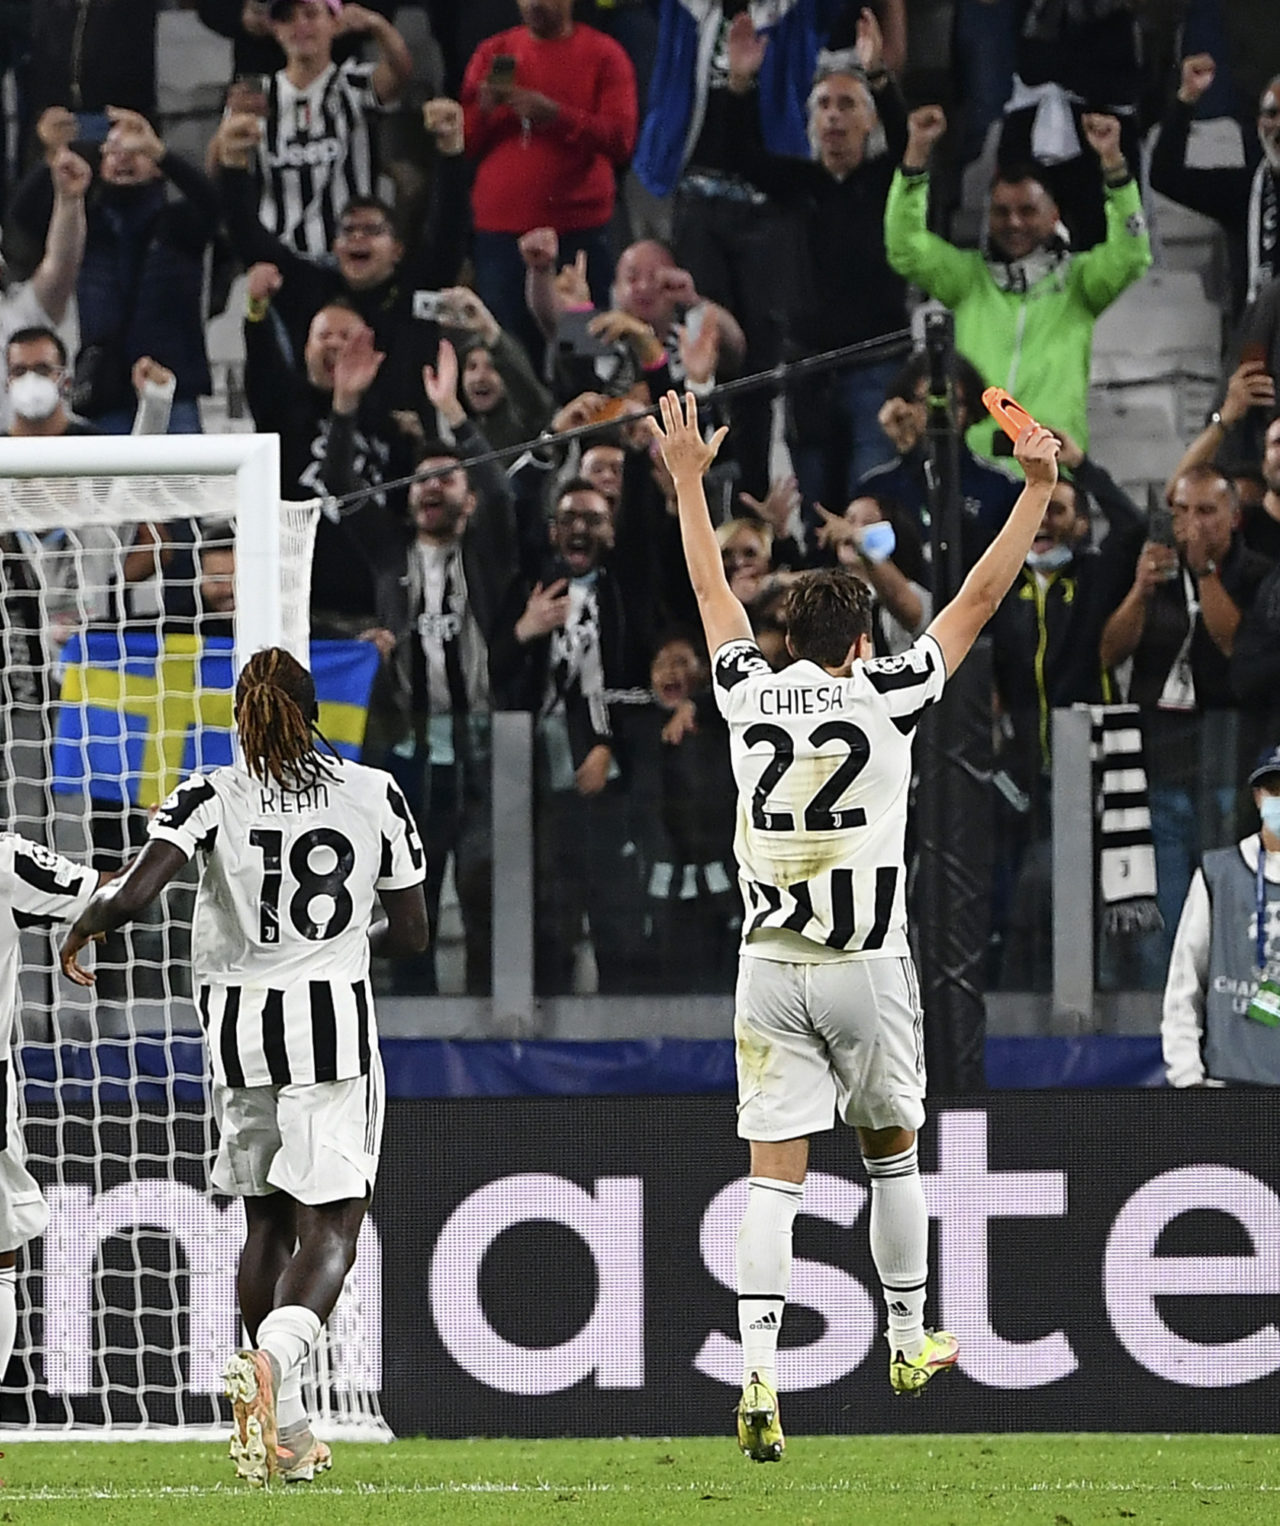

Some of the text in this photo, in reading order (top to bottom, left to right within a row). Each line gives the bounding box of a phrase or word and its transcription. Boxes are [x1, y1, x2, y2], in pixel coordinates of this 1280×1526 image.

[269, 138, 342, 168] Jeep
[417, 612, 462, 642] eep
[760, 685, 843, 715] CHIESA
[743, 720, 871, 831] 22
[260, 784, 329, 814] KEAN
[250, 828, 355, 943] 18
